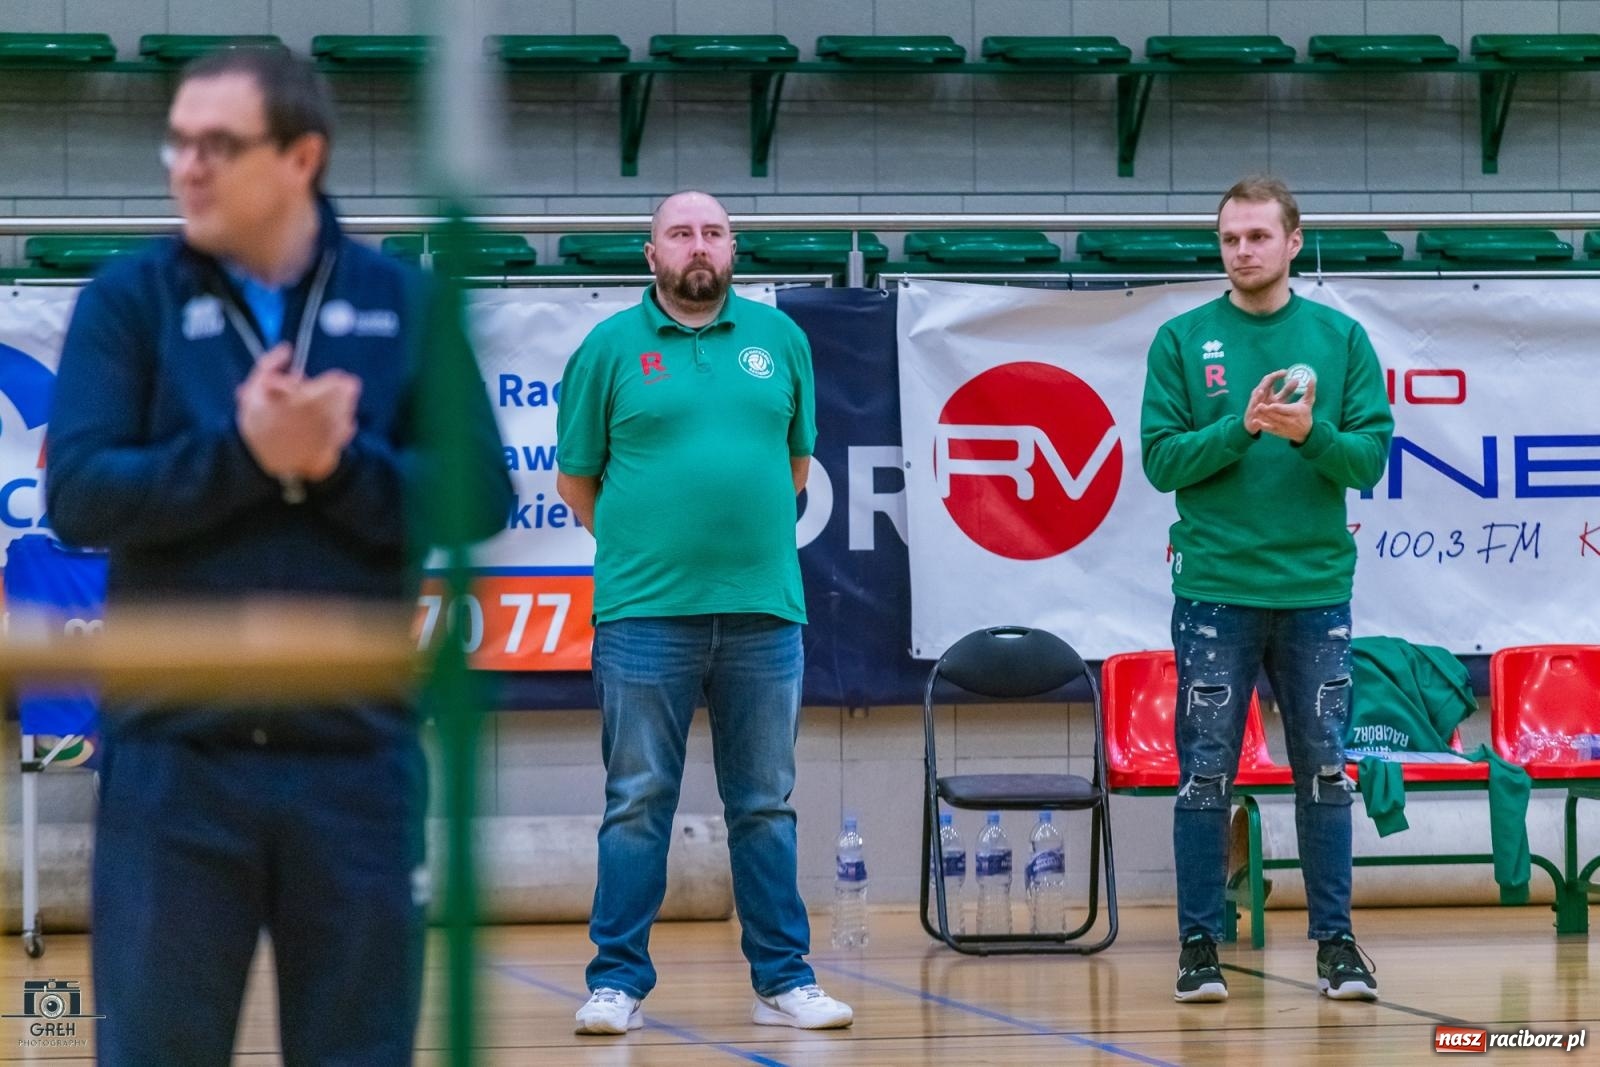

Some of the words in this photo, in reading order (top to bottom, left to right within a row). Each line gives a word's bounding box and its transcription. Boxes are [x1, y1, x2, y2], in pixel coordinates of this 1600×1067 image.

[640, 352, 667, 376] R
[1205, 364, 1227, 388] R
[1387, 368, 1466, 405] IO
[502, 445, 557, 471] aw
[934, 423, 1121, 501] RV
[1360, 434, 1600, 500] NE
[0, 478, 48, 529] C
[509, 493, 584, 530] kie
[1375, 530, 1465, 564] 100,3
[1477, 521, 1541, 563] FM
[500, 592, 571, 653] 77
[1353, 724, 1409, 747] RACIBÓRZ
